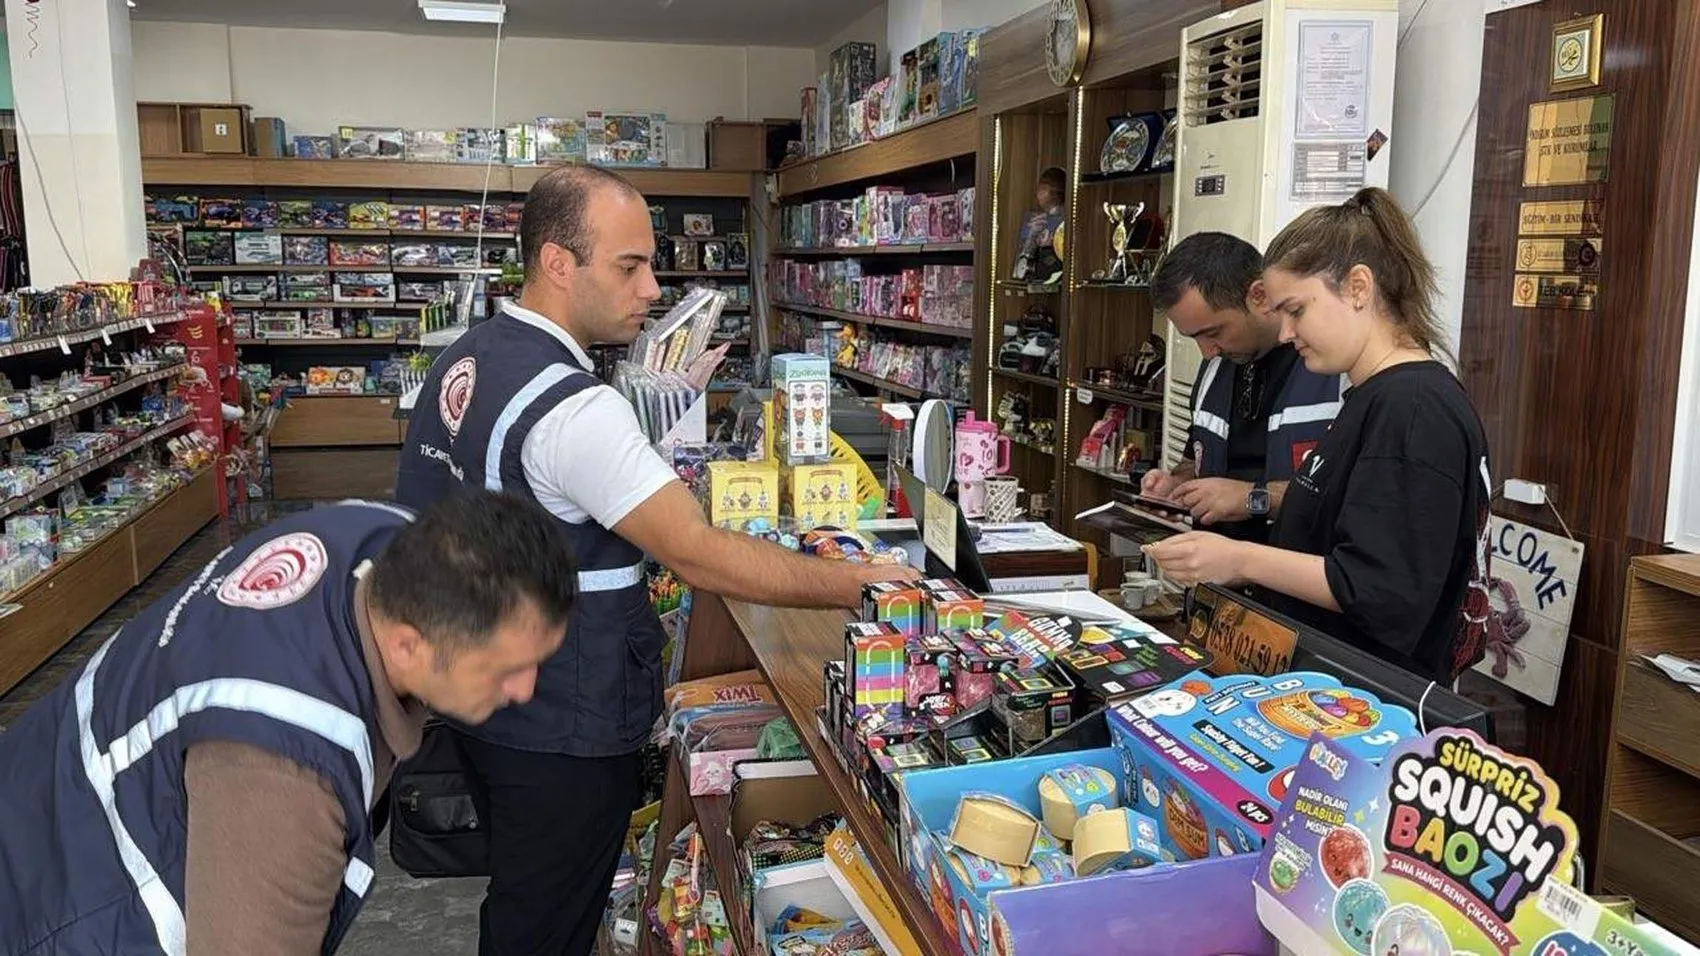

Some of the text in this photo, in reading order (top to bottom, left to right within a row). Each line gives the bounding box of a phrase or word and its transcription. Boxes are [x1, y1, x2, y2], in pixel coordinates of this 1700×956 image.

[1492, 523, 1567, 610] COME
[1298, 786, 1322, 803] NADİR
[1394, 758, 1554, 883] SQUISH
[1439, 742, 1540, 813] SÜRPRİZ
[1389, 803, 1523, 912] BAOZI
[1391, 858, 1510, 944] SANA HANGİ RENK ÇIKACAK?
